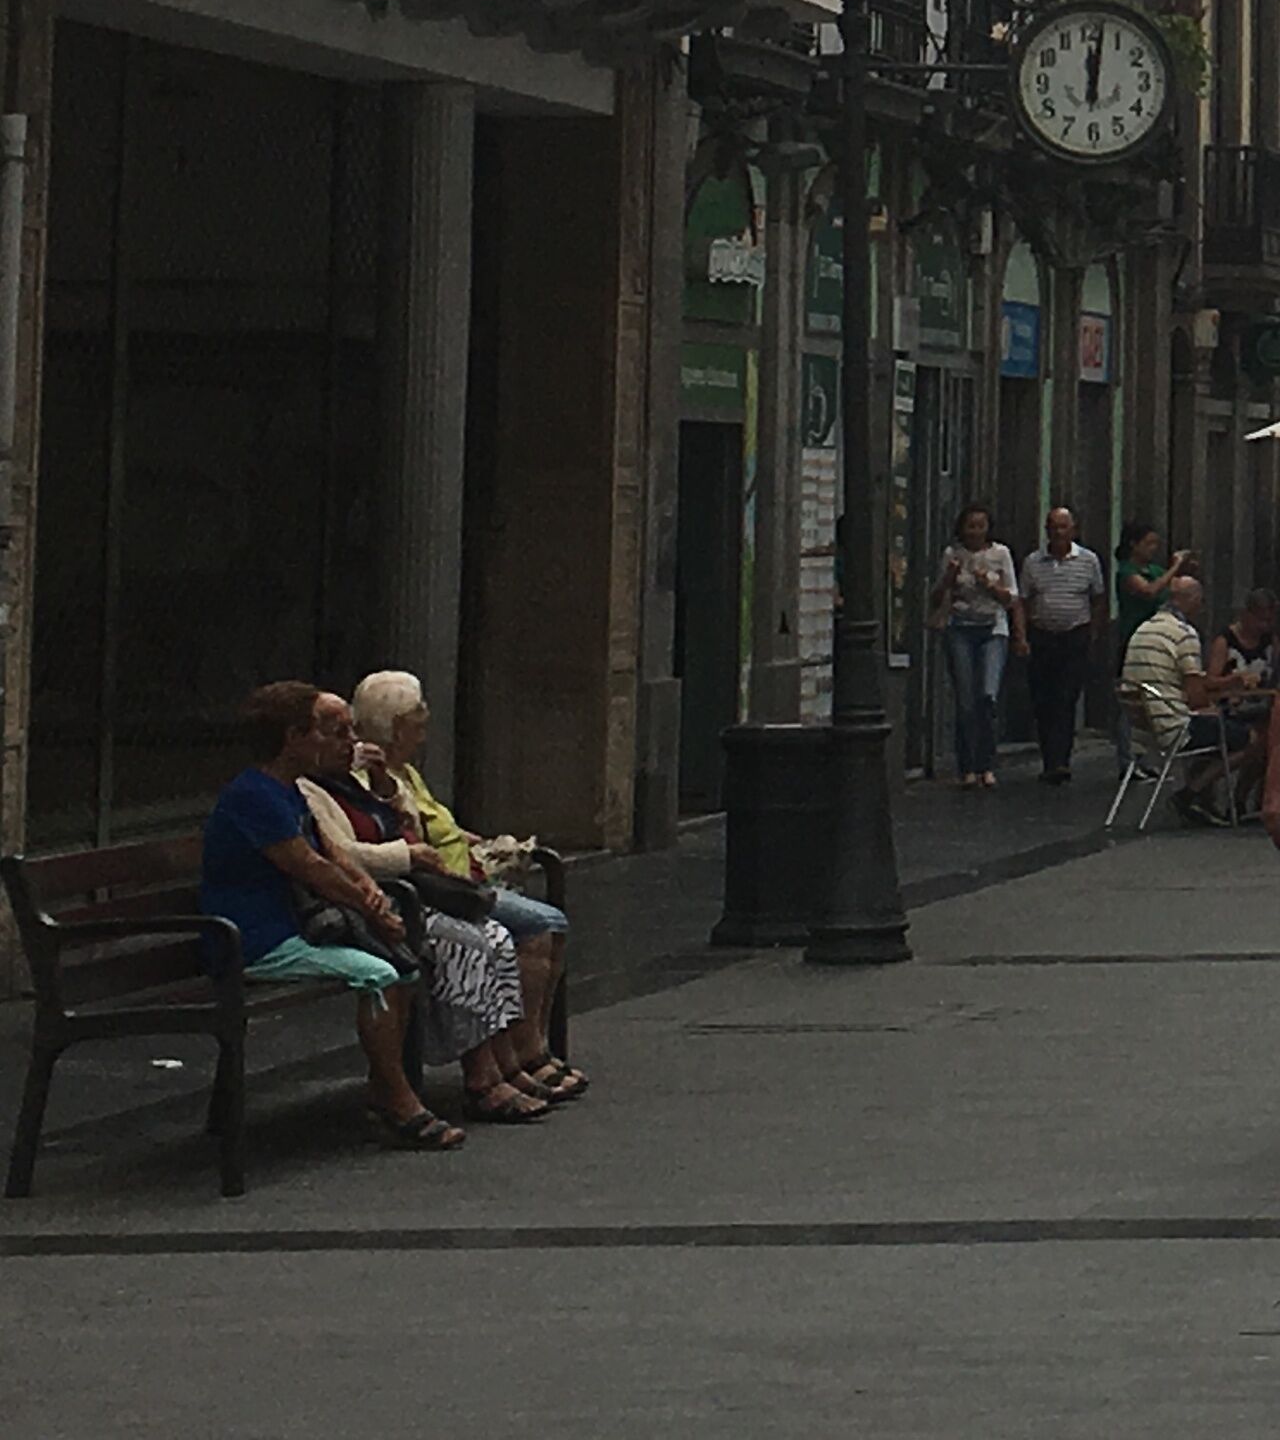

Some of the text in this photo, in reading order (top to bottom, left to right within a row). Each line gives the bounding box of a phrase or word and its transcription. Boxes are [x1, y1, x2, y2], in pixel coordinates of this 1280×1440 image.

[1059, 30, 1071, 51] 11
[1114, 31, 1121, 51] 1
[1040, 48, 1057, 68] 10
[1129, 47, 1144, 68] 2
[1036, 72, 1049, 95] 9
[1137, 71, 1151, 93] 3
[1042, 97, 1056, 119] 8
[1128, 97, 1143, 117] 4
[1062, 115, 1076, 139] 7
[1087, 121, 1100, 143] 6
[1112, 115, 1124, 136] 5
